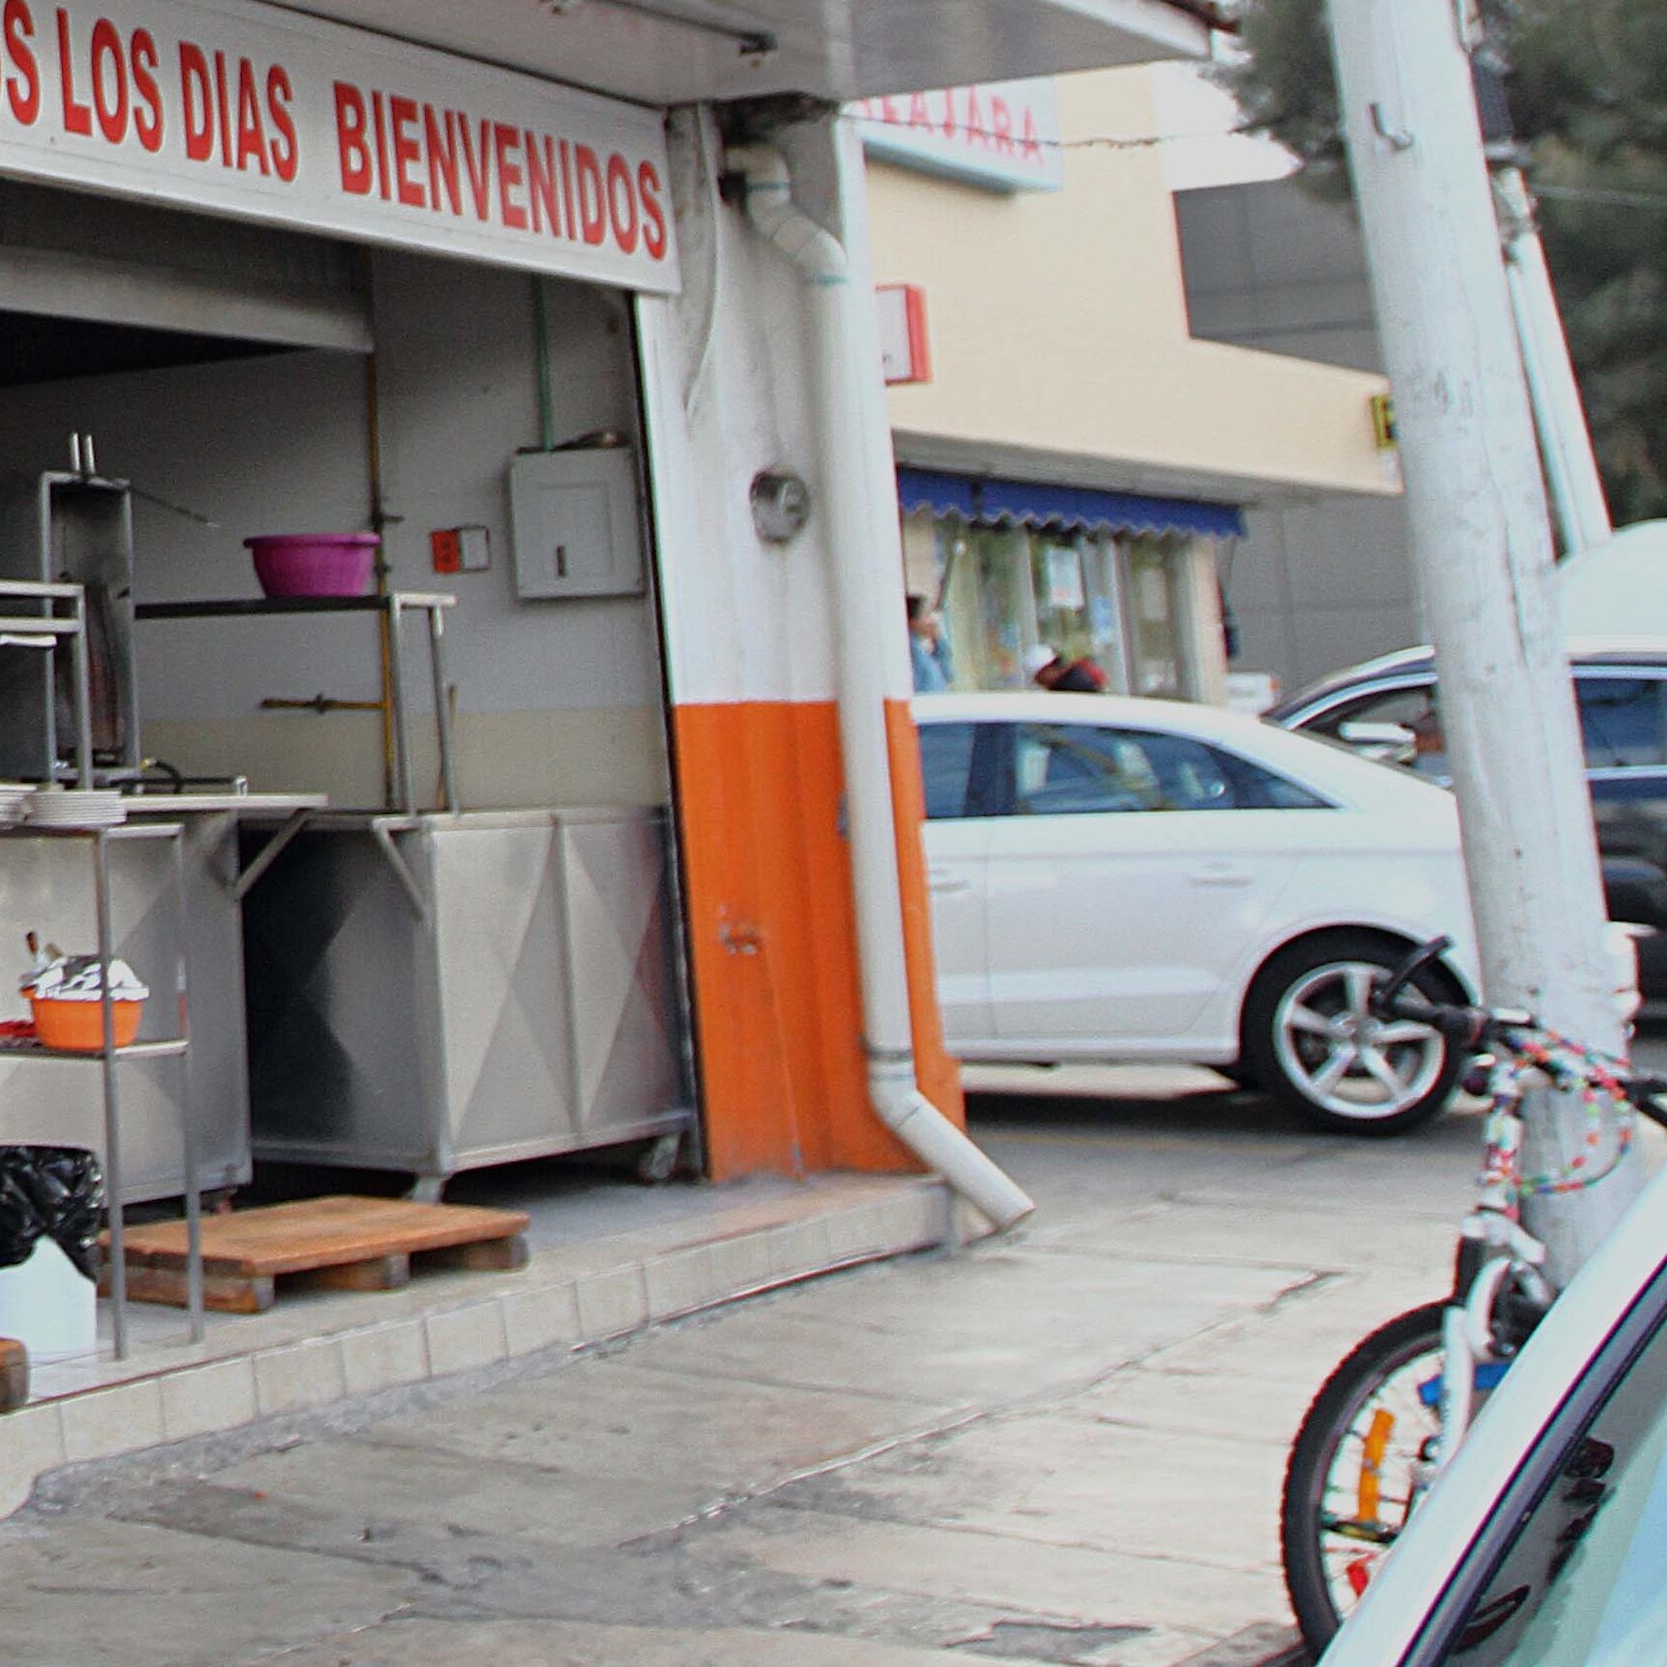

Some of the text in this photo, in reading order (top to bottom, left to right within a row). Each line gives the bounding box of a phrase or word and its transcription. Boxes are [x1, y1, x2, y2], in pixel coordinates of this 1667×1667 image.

[55, 6, 165, 154] LOS
[178, 39, 299, 183] DIAS
[332, 79, 666, 262] BIENVENIDOS
